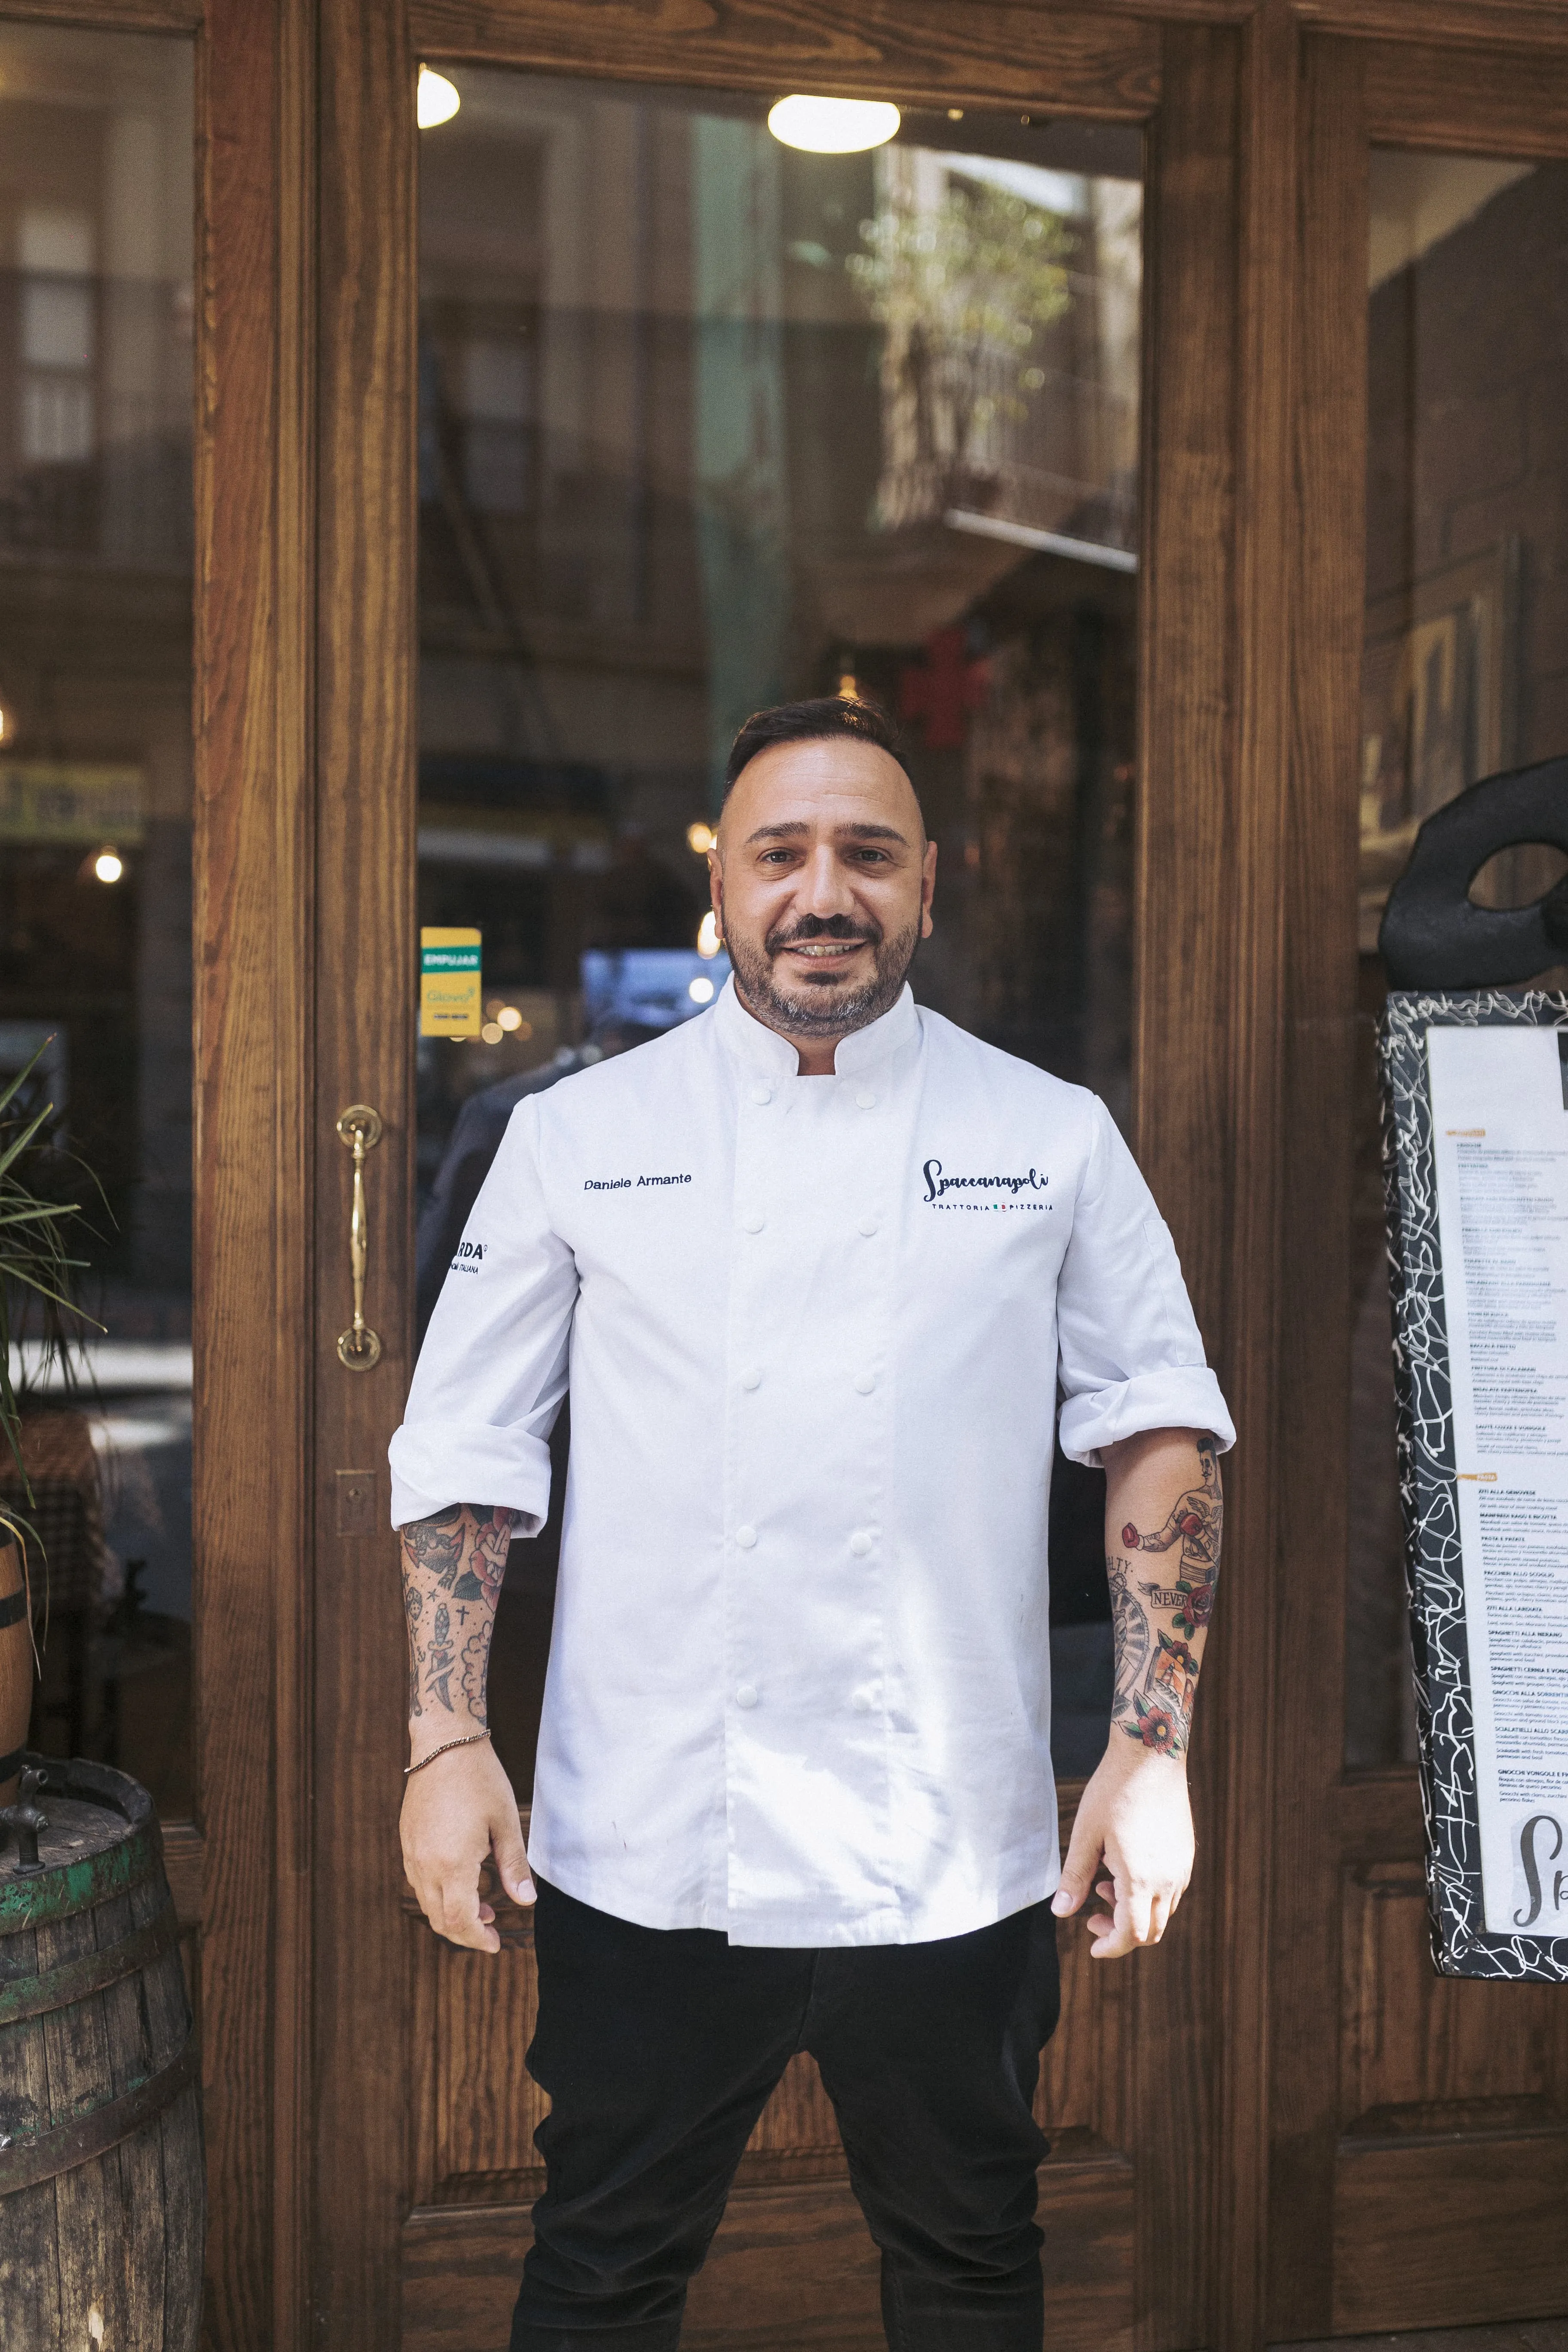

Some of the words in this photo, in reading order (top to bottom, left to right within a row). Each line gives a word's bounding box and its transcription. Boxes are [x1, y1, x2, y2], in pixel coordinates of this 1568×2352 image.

[424, 954, 477, 965] EMPUJAR
[584, 1178, 631, 1190] Daniele
[637, 1174, 691, 1186] Armante
[923, 1159, 1048, 1202] Spaccanapoli
[1153, 1592, 1187, 1607] NEVER
